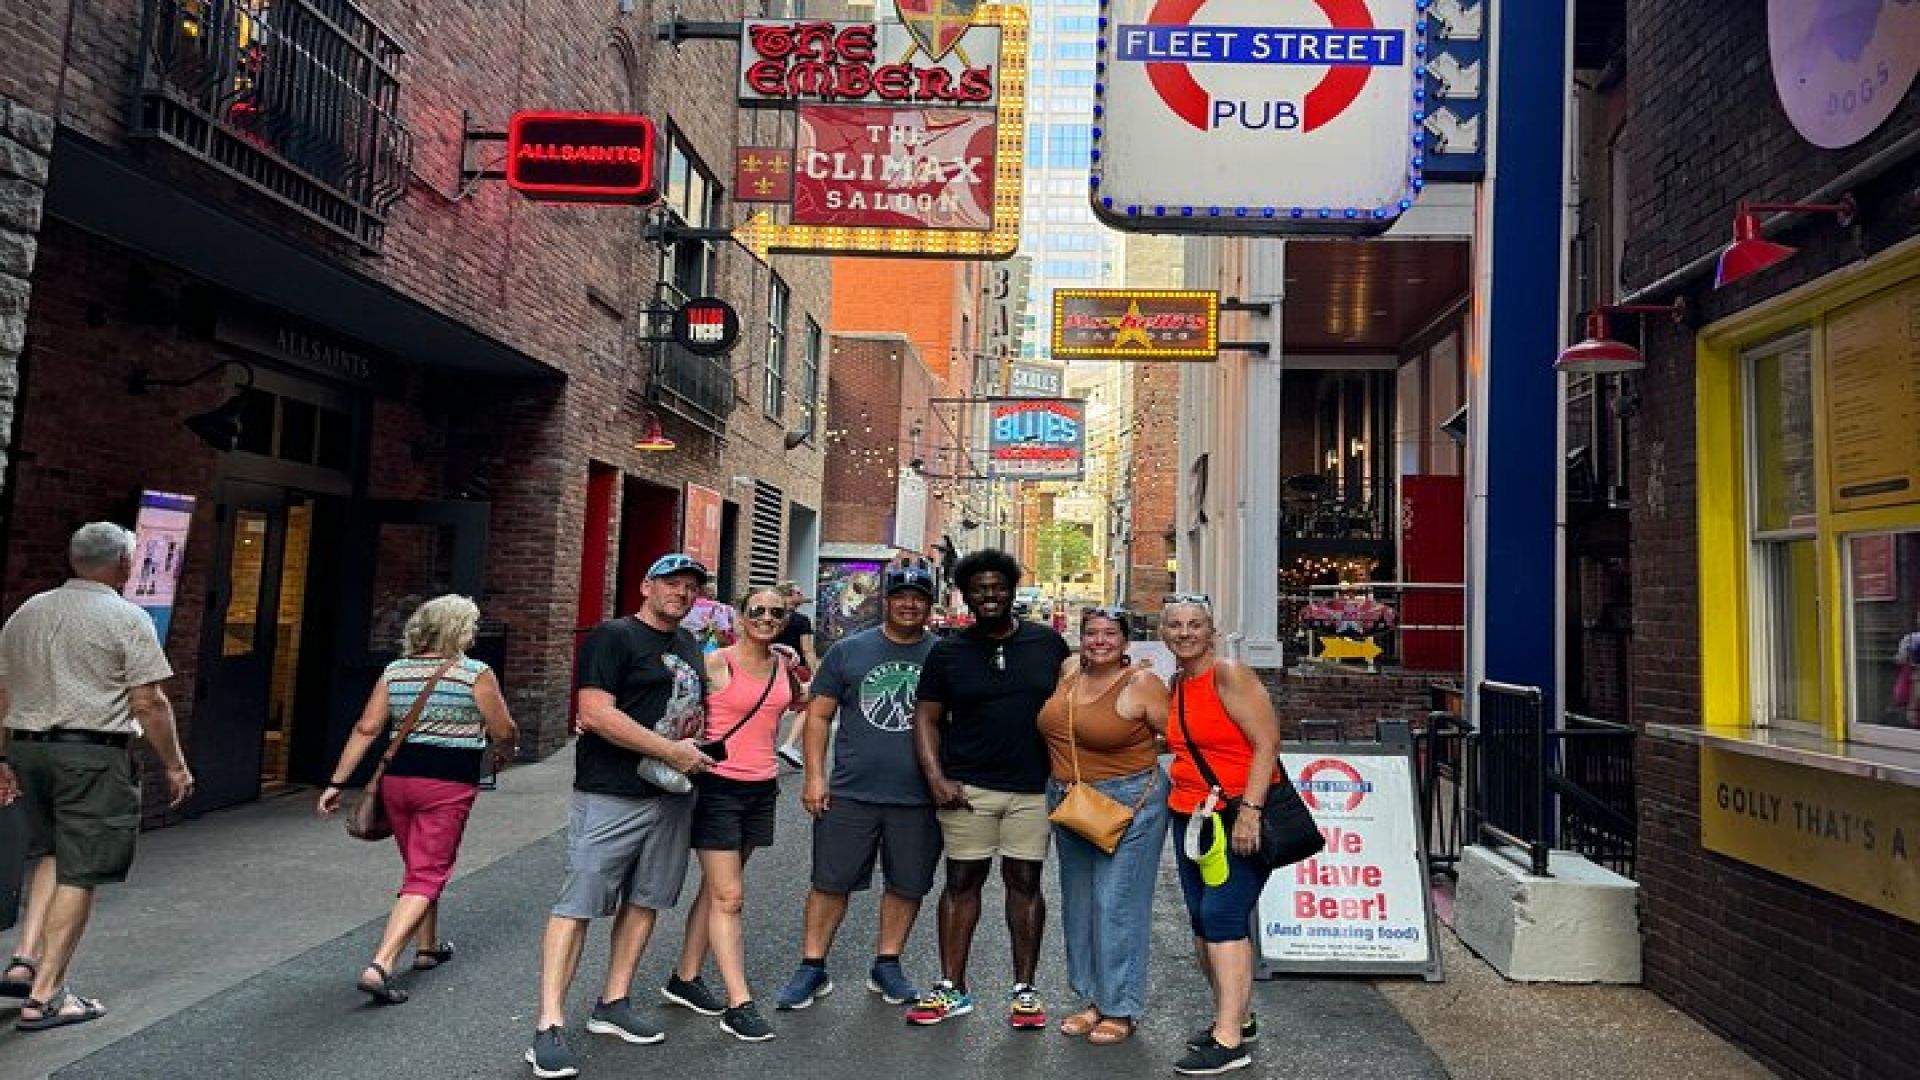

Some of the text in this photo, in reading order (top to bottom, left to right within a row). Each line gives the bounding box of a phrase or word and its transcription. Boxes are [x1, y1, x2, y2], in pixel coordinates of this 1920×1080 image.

[1126, 31, 1396, 61] FLEET STREET
[746, 60, 993, 101] EMBERS
[1212, 101, 1299, 129] PUB
[866, 125, 926, 144] THE
[517, 143, 641, 163] ALLSAINTS
[807, 151, 982, 184] CLIMAX
[826, 190, 960, 212] SALOON
[995, 410, 1078, 442] BLUES
[1716, 783, 1782, 825] GOLLY
[1793, 801, 1876, 850] THAT'S
[1295, 859, 1382, 888] Have
[1293, 890, 1388, 921] Beer!
[1306, 924, 1374, 941] amazing
